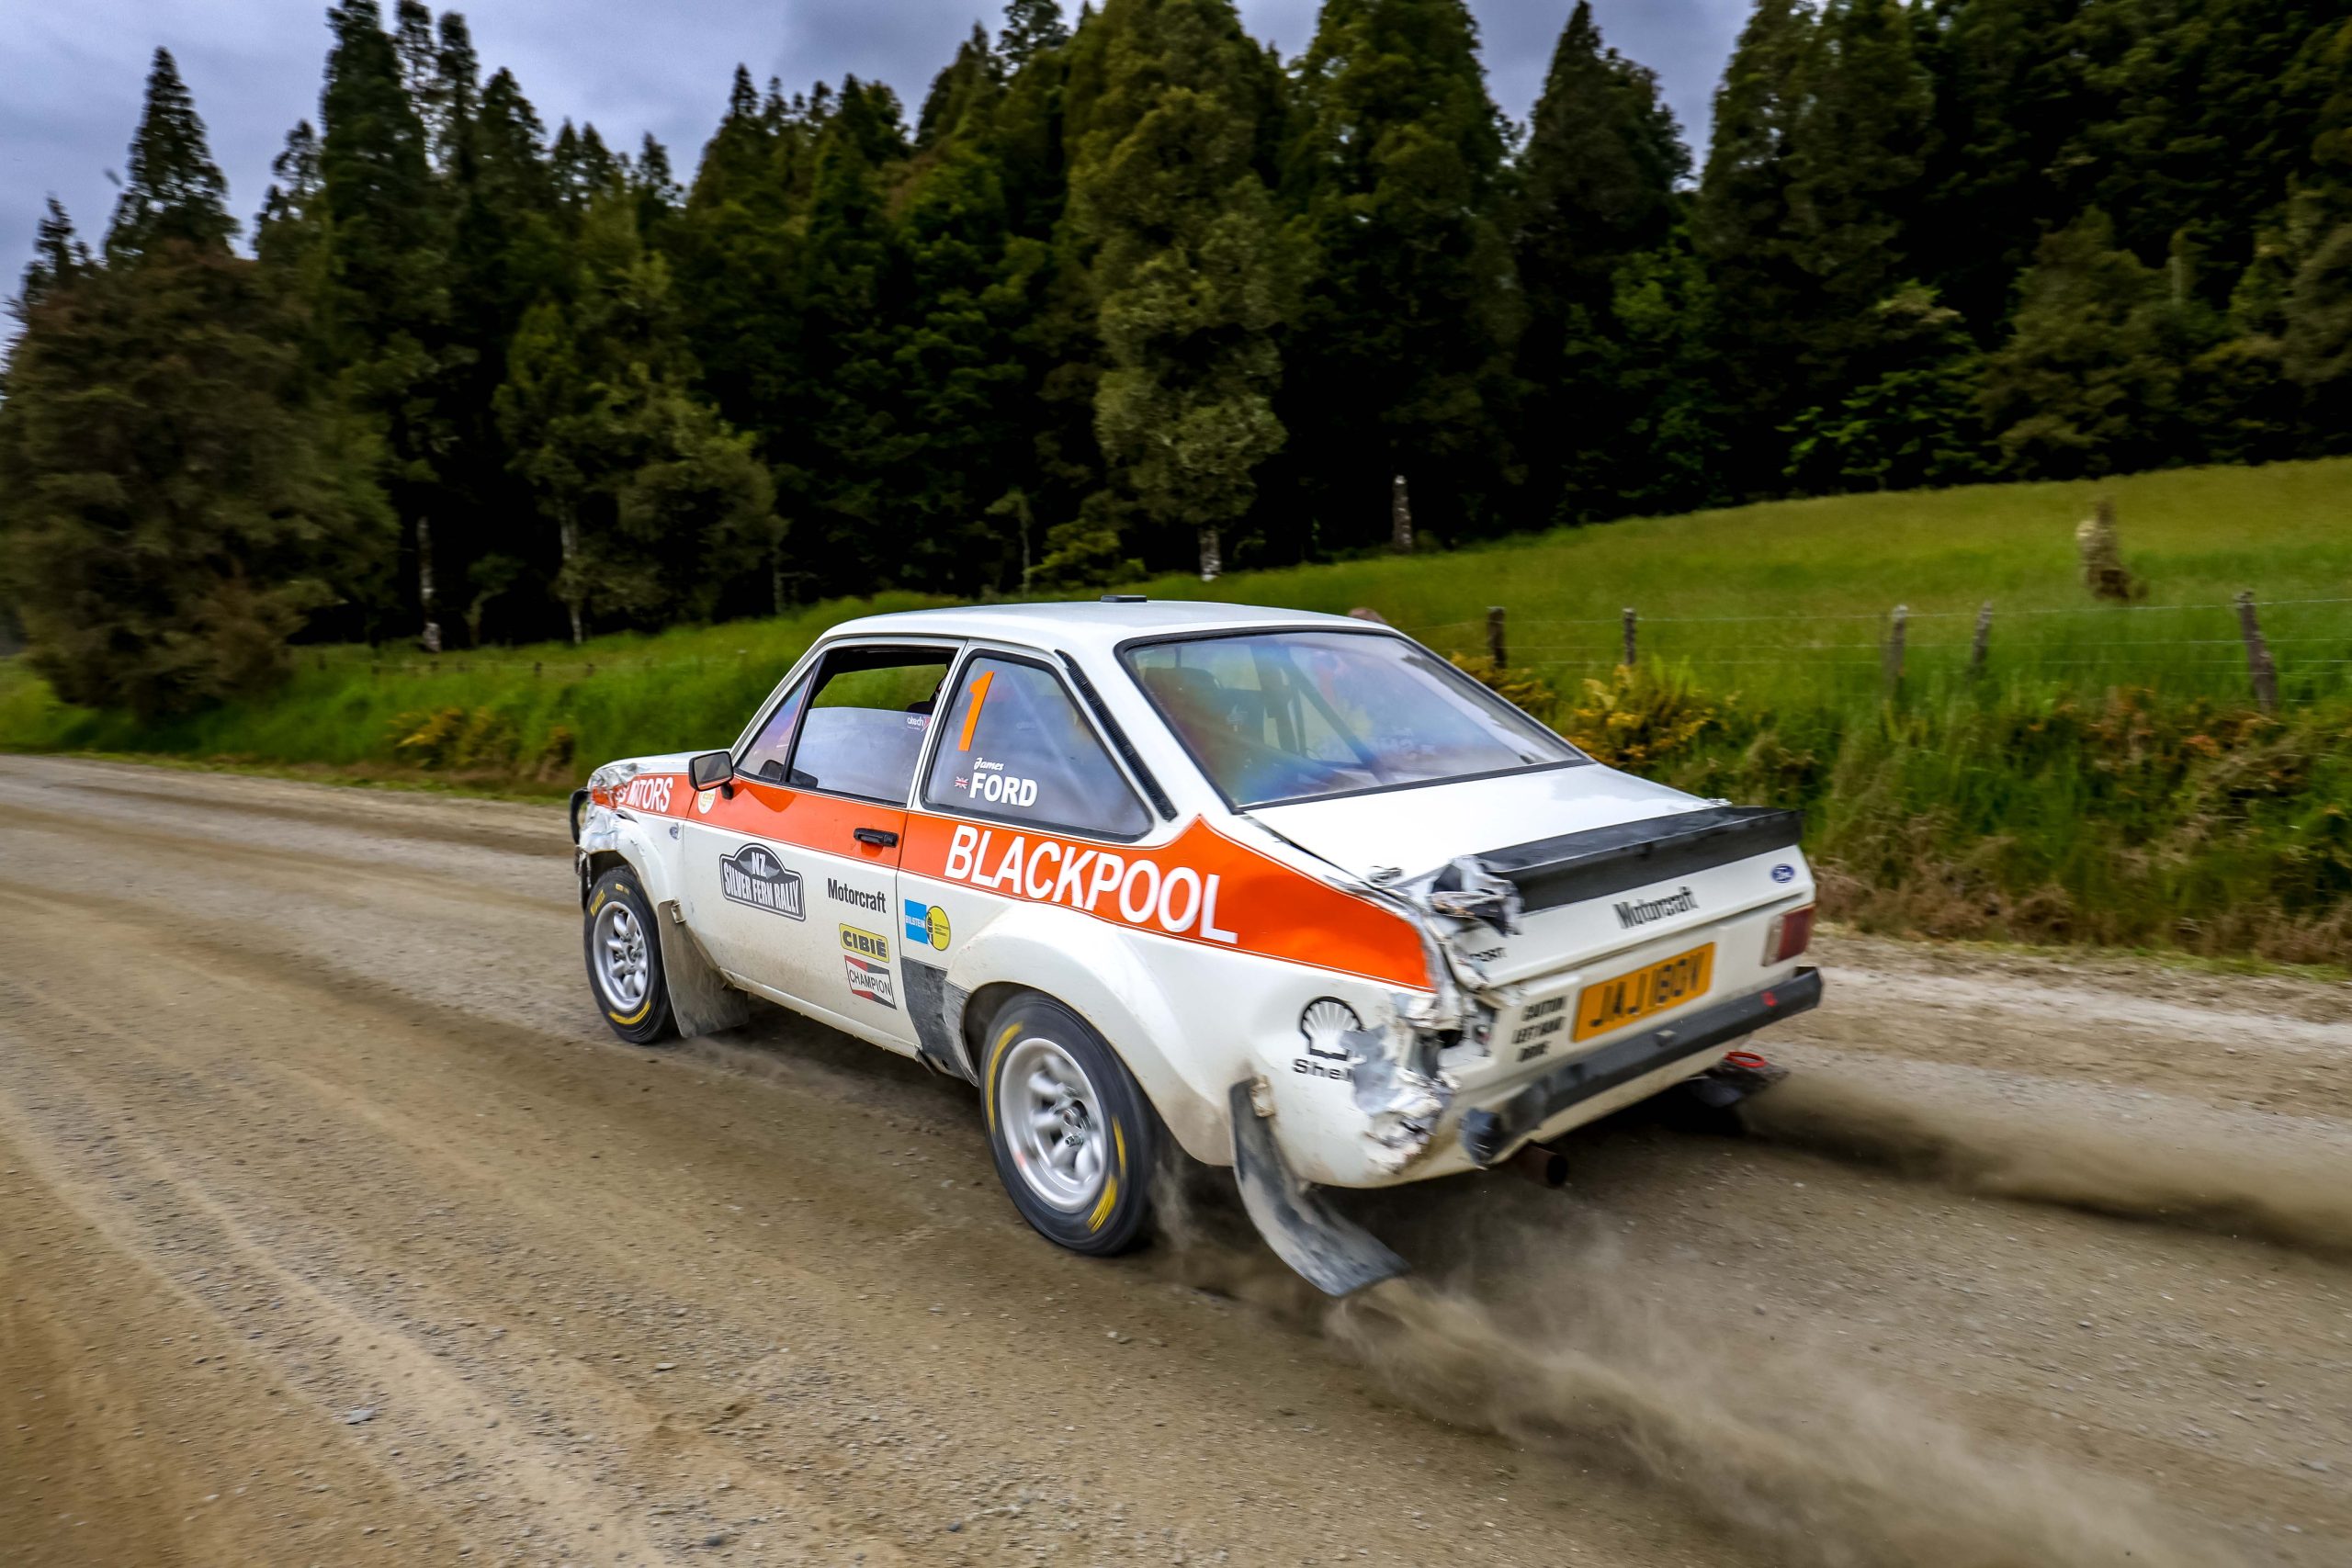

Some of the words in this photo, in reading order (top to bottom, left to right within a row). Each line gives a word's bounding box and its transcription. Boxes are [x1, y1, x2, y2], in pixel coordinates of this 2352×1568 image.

[957, 671, 995, 751] 1
[974, 756, 1004, 772] James
[969, 772, 1038, 807] FORD
[752, 852, 767, 877] NZ
[723, 862, 752, 901] SILVER
[752, 878, 775, 907] FERN
[774, 879, 799, 914] RALLY
[827, 877, 887, 914] Motorcraft
[944, 825, 1238, 944] BLACKPOOL
[1612, 886, 1700, 930] Motorcraft
[848, 969, 891, 996] CHAMPION
